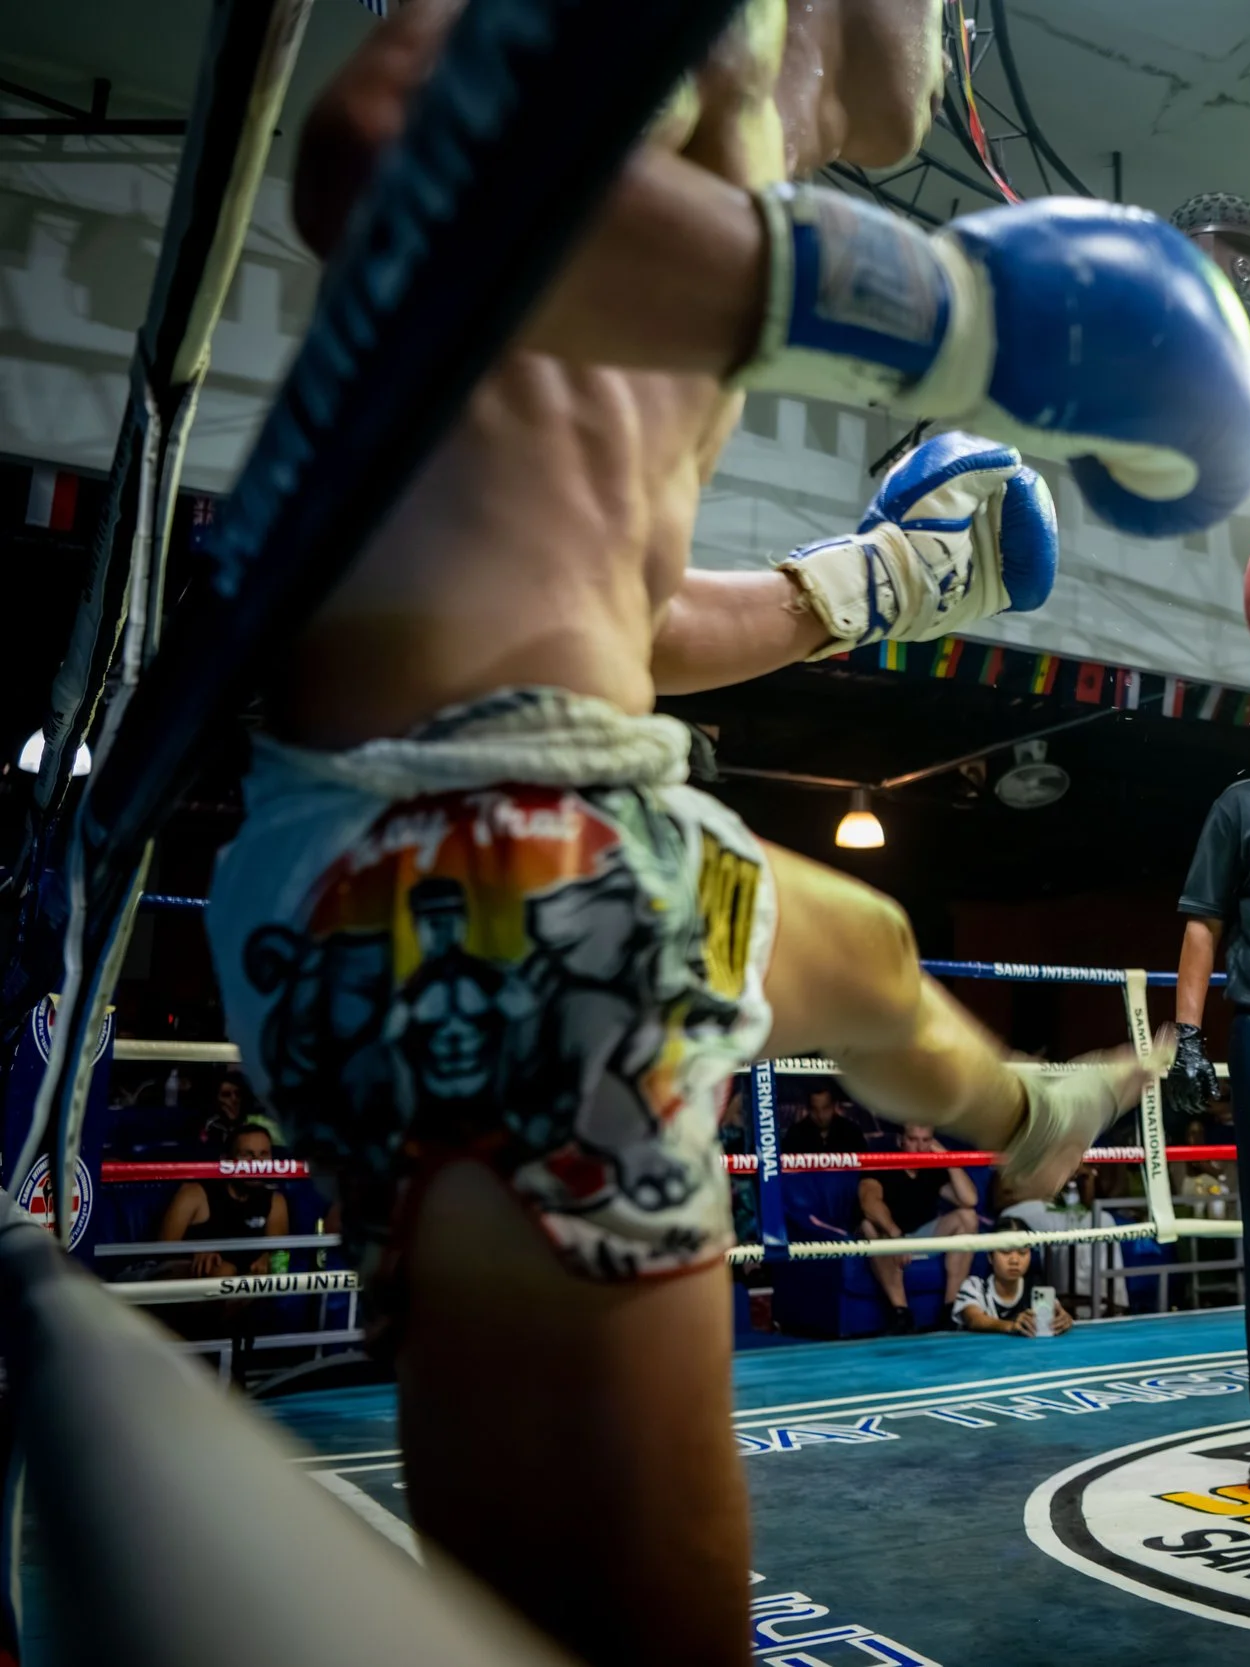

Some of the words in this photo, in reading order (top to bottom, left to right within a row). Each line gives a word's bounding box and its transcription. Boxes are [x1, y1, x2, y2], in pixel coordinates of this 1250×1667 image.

[994, 962, 1039, 978] SAMUI
[1042, 965, 1126, 983] INTERNATION
[219, 1158, 298, 1175] SAMUI
[219, 1276, 298, 1295] SAMUI
[306, 1273, 358, 1291] INTE
